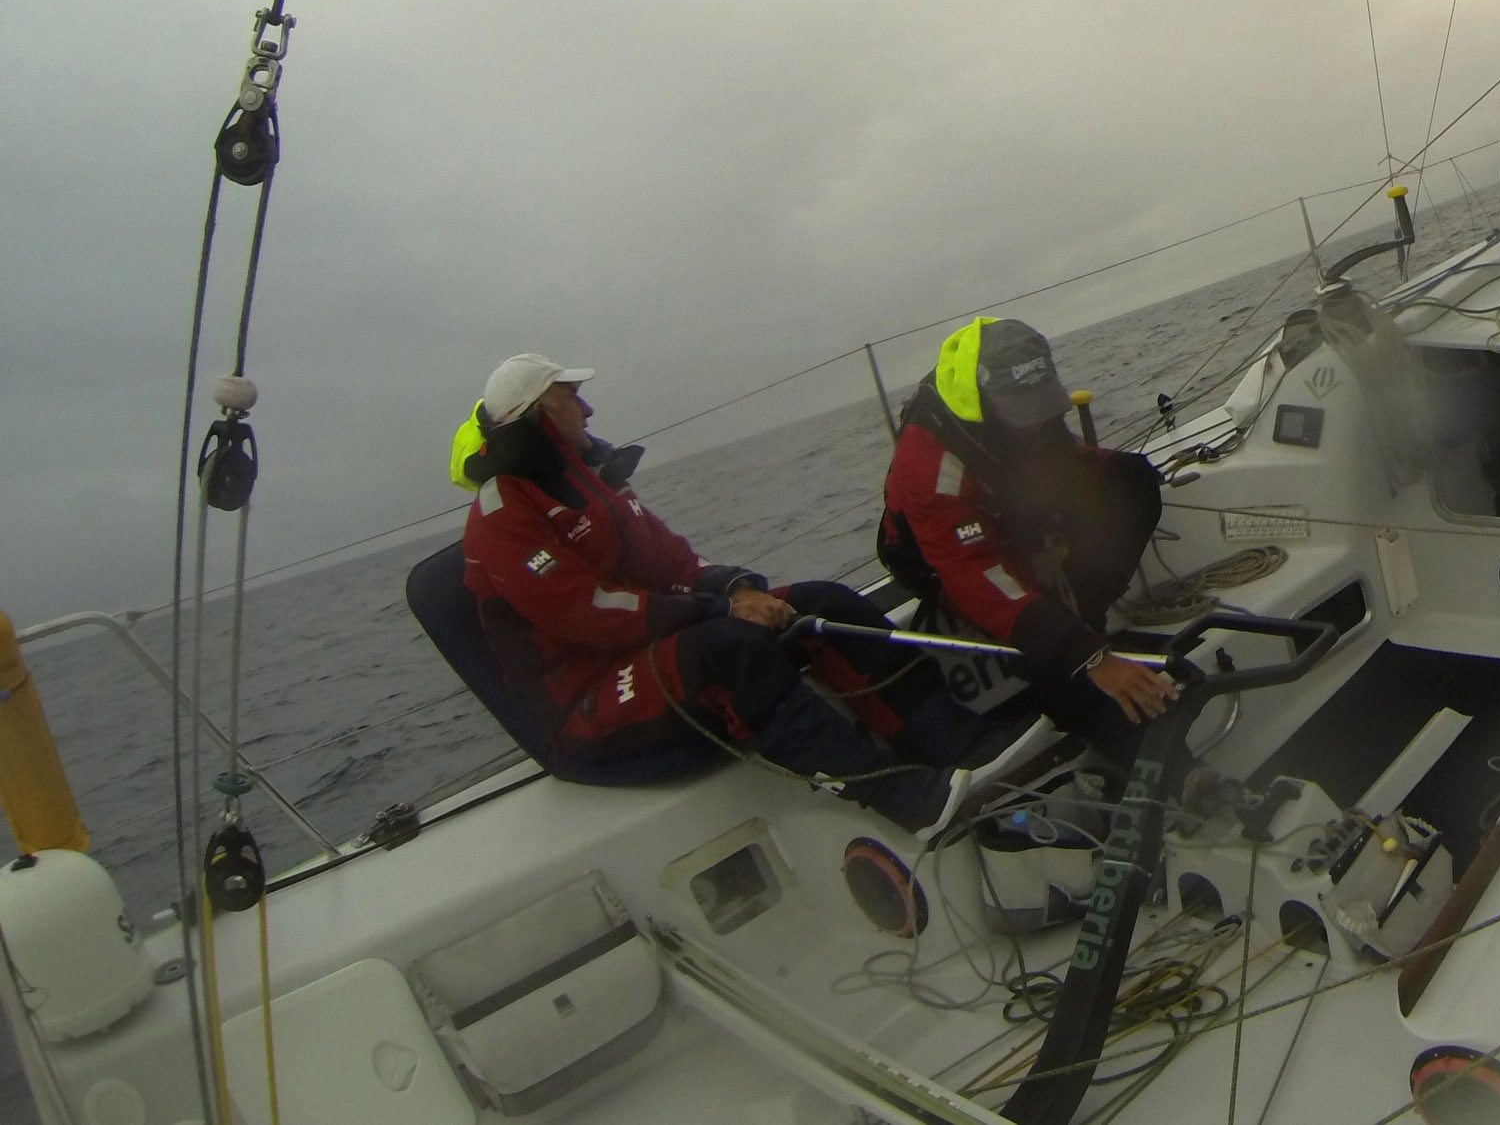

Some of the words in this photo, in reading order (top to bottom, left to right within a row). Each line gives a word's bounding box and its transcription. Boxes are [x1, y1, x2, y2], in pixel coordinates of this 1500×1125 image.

[957, 522, 982, 540] HH
[527, 550, 552, 571] HH
[617, 664, 635, 704] HH
[1071, 758, 1164, 971] Fertiberia
